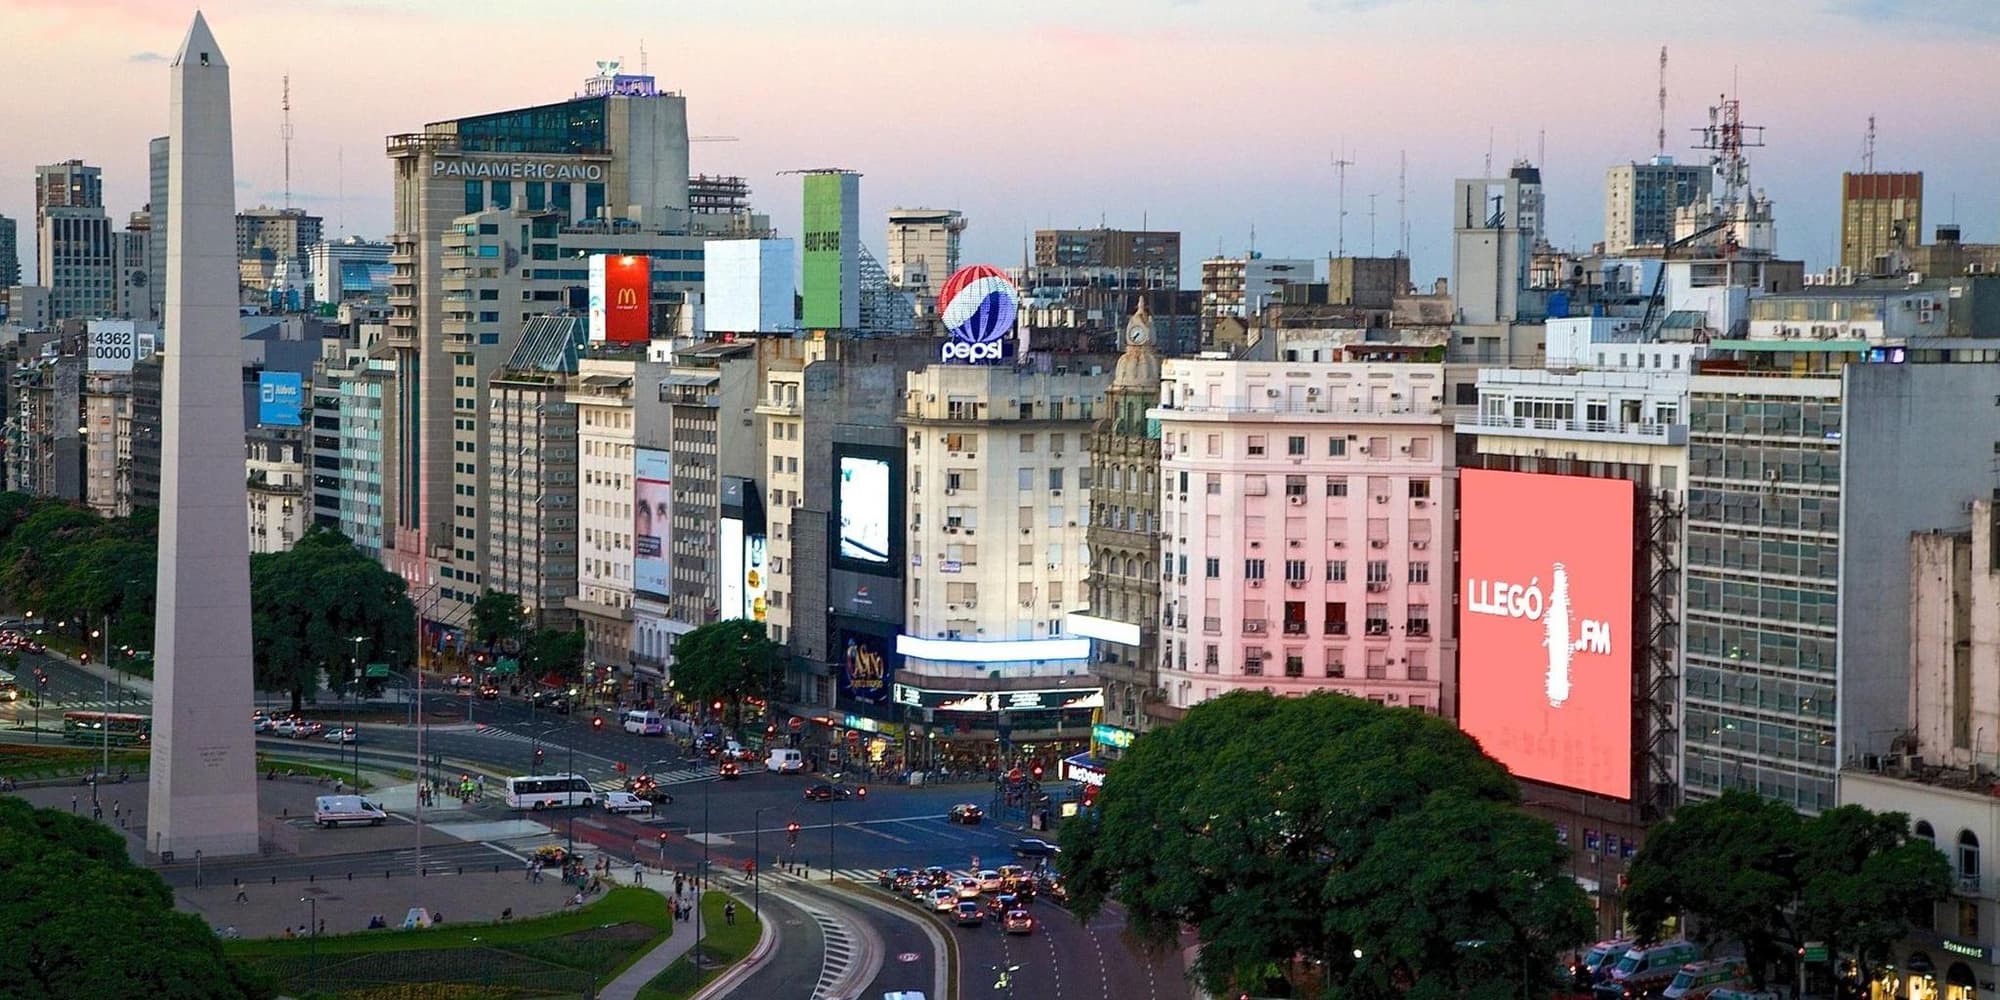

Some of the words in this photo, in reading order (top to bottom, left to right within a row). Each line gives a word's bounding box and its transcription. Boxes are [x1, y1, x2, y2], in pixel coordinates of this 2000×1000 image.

[433, 160, 601, 180] PANAMERICANO
[95, 332, 131, 345] 4362
[95, 346, 131, 359] 0000
[942, 338, 1003, 363] pepsi
[1468, 576, 1543, 621] LLEGÓ
